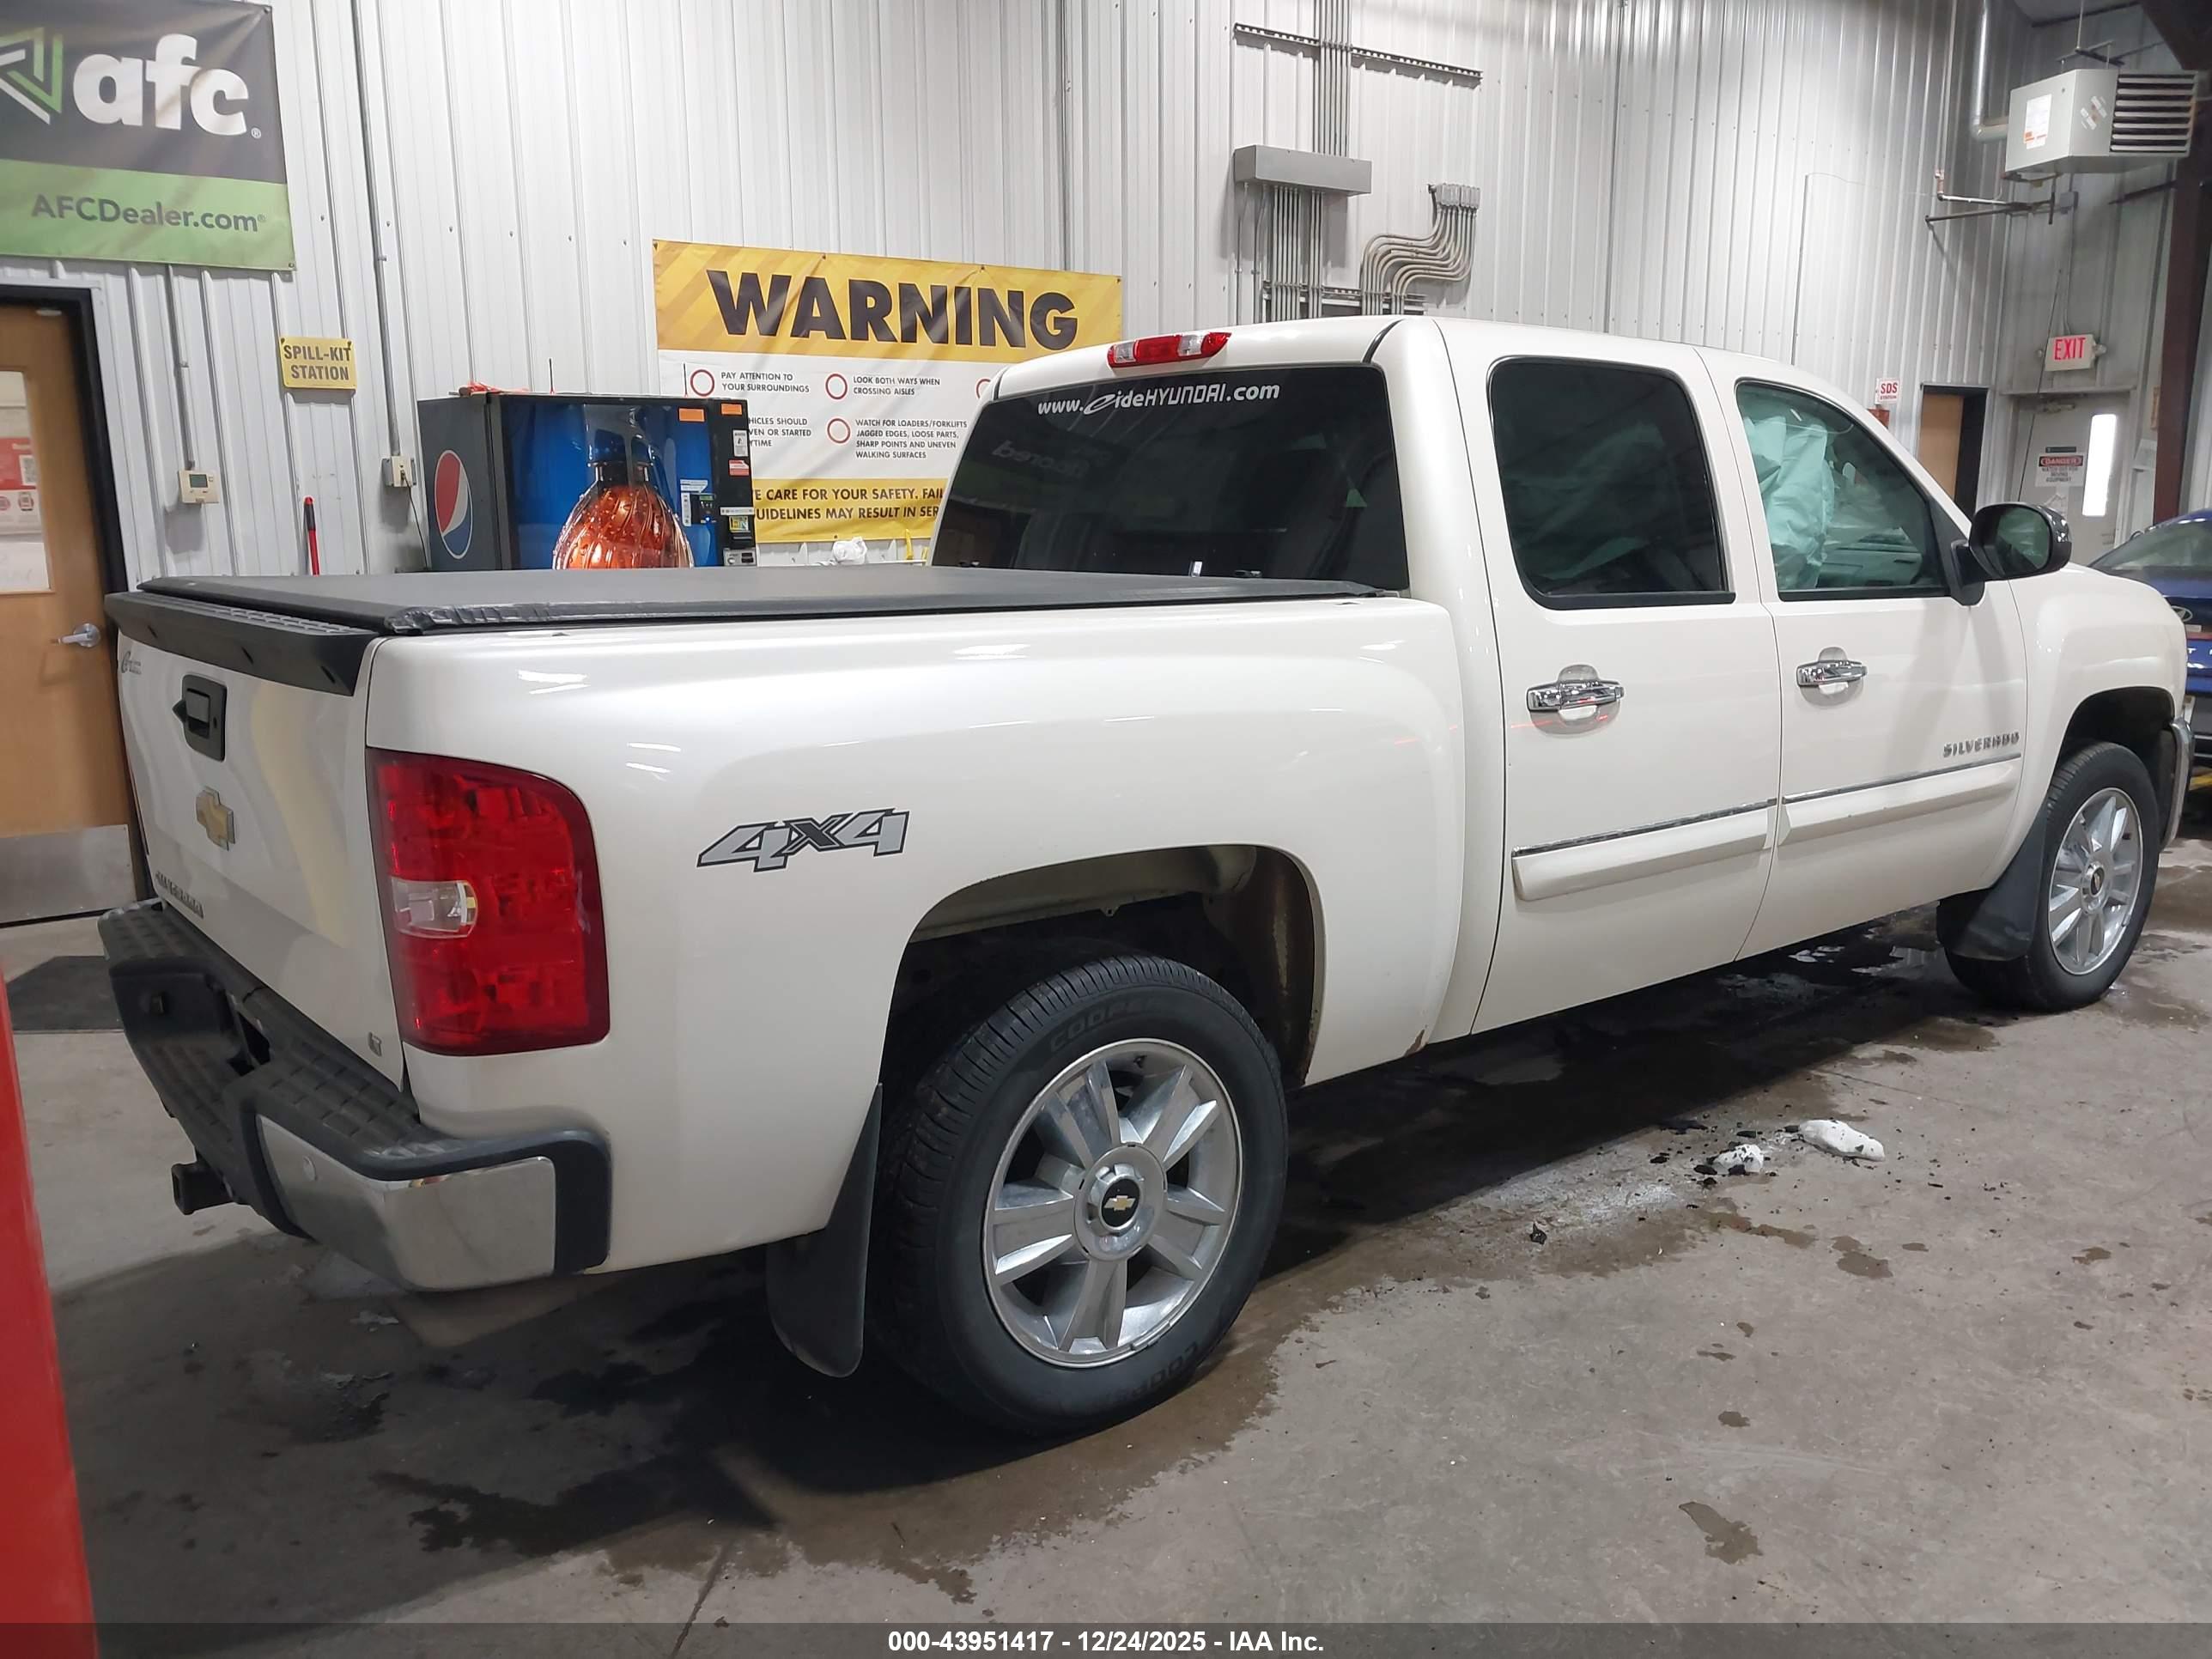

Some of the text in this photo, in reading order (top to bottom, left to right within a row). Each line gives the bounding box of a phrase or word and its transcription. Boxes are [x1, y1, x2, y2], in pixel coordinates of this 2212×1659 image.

[73, 33, 248, 136] afc
[31, 194, 258, 232] AFCDealer.com
[707, 269, 1079, 350] WARNING
[283, 345, 351, 361] SPILL-KIT
[2054, 337, 2087, 361] EXIT
[291, 365, 349, 380] STATION
[739, 372, 781, 380] ATTENTION
[853, 376, 873, 385] LOOK
[722, 383, 810, 392] YOUR SURROUNDINGS
[853, 386, 915, 396] CROSSING AISLES
[1881, 382, 1898, 394] SDS
[776, 417, 808, 426] SHOULD
[781, 428, 811, 437] STARTED
[766, 489, 798, 501] CARE
[802, 489, 828, 500] FOR
[831, 488, 866, 500] YOUR
[872, 488, 919, 500] SAFETY.
[825, 507, 854, 519] MAY
[858, 507, 900, 519] RESULT
[903, 506, 916, 518] IN
